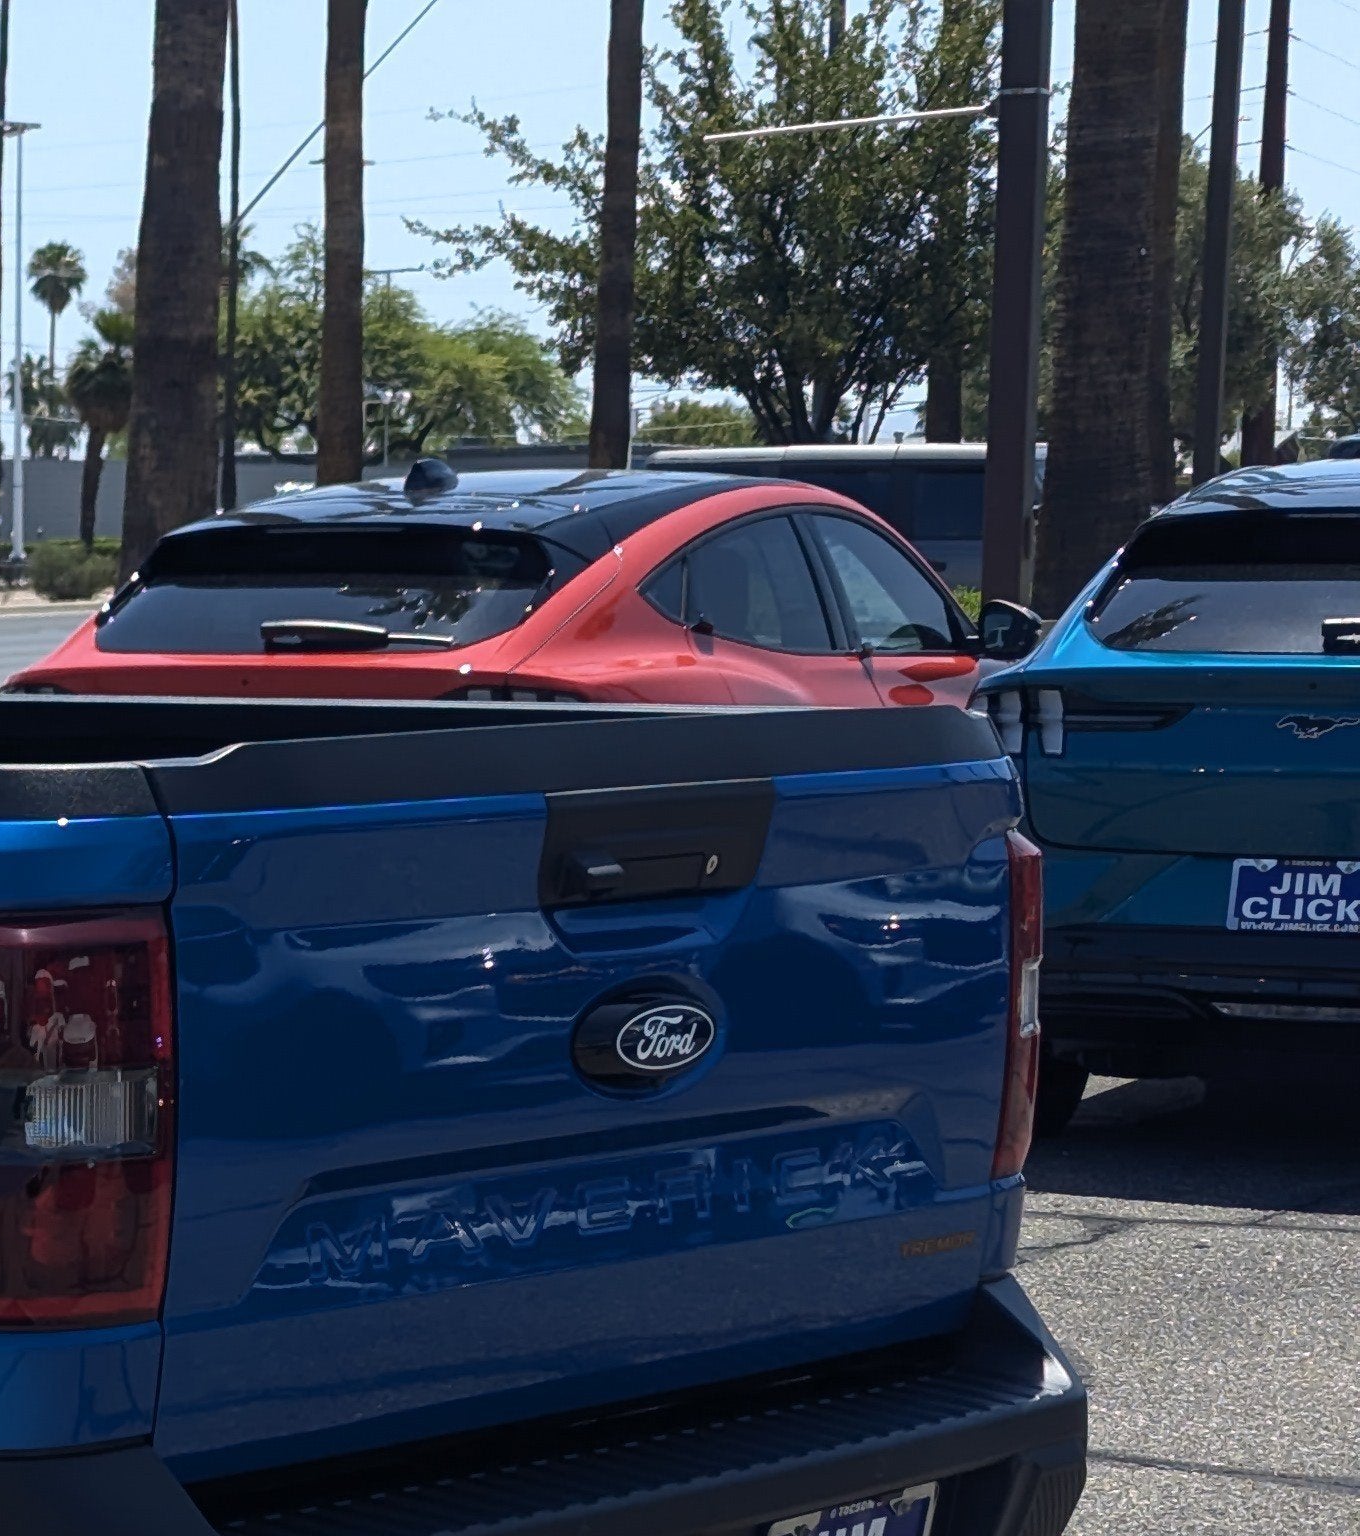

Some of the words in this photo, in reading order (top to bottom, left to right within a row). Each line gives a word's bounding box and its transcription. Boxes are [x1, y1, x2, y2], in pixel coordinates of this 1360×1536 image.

[1269, 872, 1342, 896] JIM
[1241, 896, 1360, 922] CLICK
[636, 1014, 698, 1061] Ford
